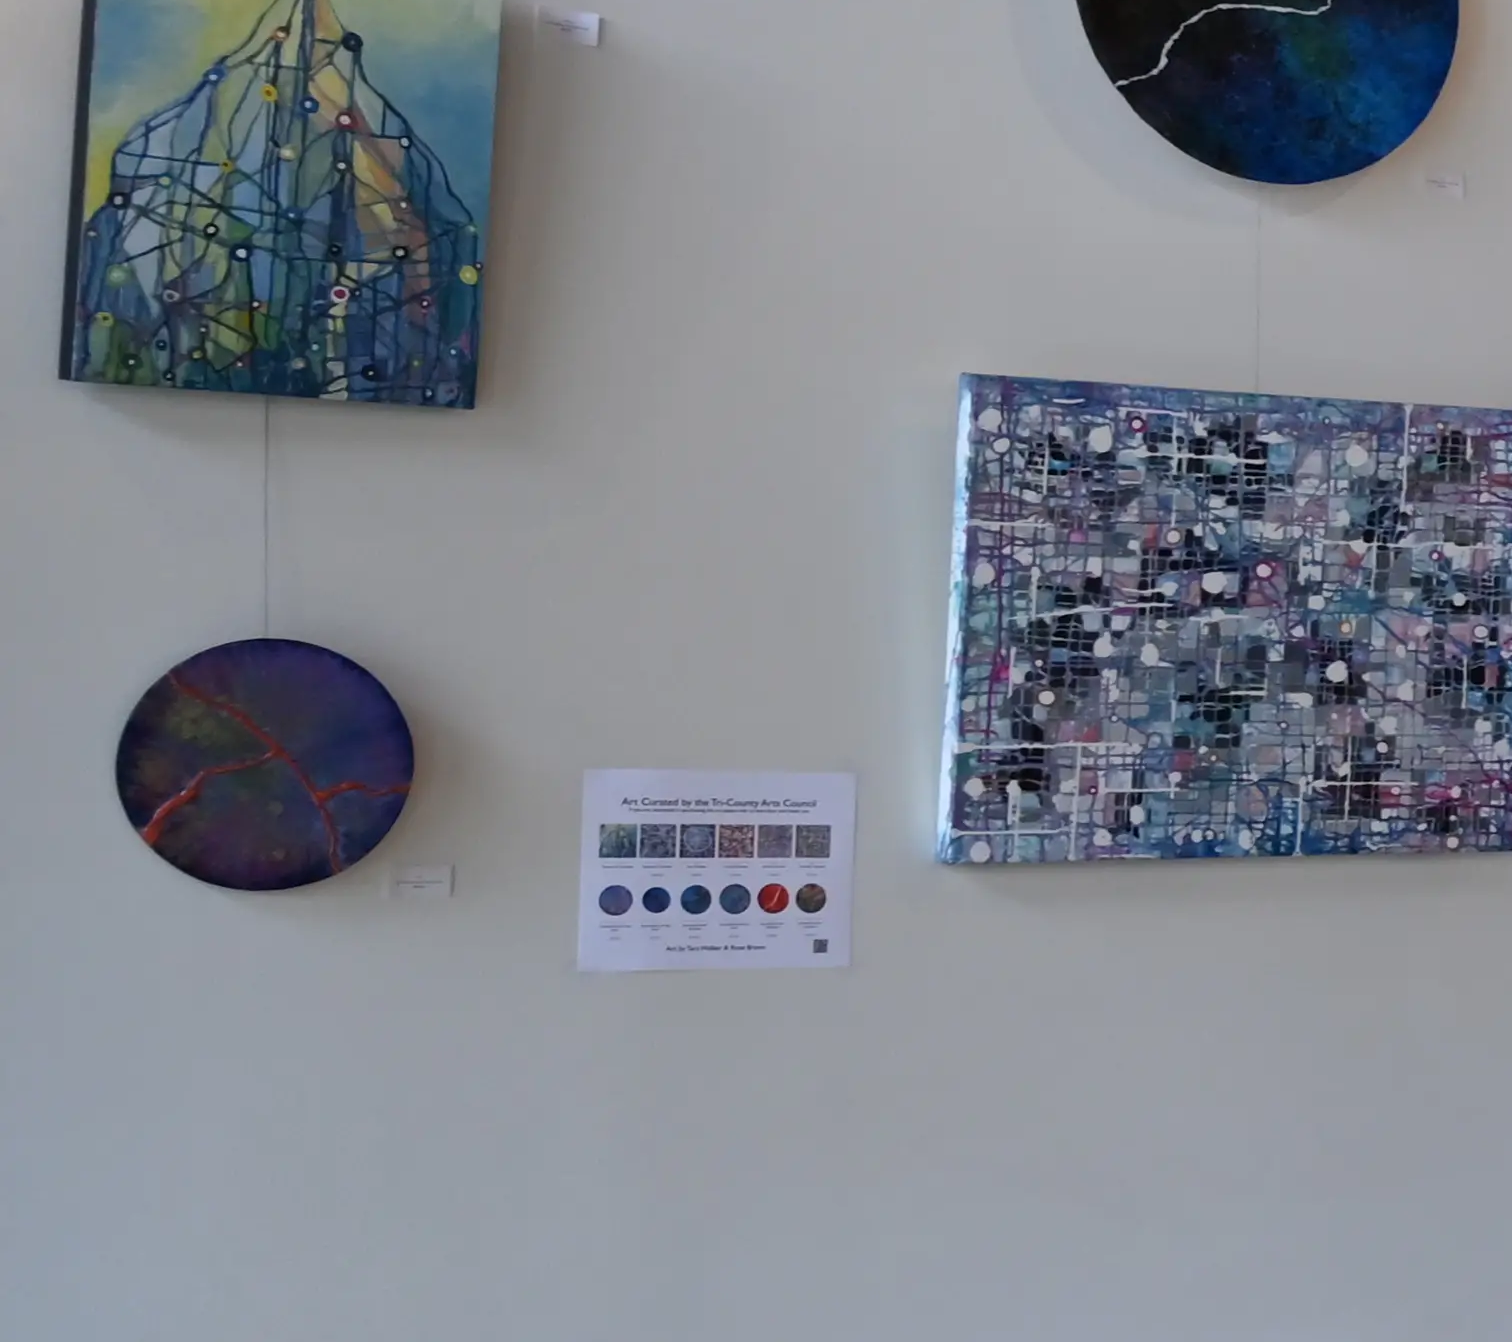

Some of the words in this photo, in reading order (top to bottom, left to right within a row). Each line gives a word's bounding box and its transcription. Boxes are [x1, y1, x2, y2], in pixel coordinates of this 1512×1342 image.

[620, 797, 638, 807] Art
[641, 797, 679, 807] Curated
[681, 798, 692, 809] by
[694, 798, 709, 807] the
[711, 797, 760, 809] Tri-County
[761, 798, 781, 808] Arts
[782, 798, 818, 808] Council
